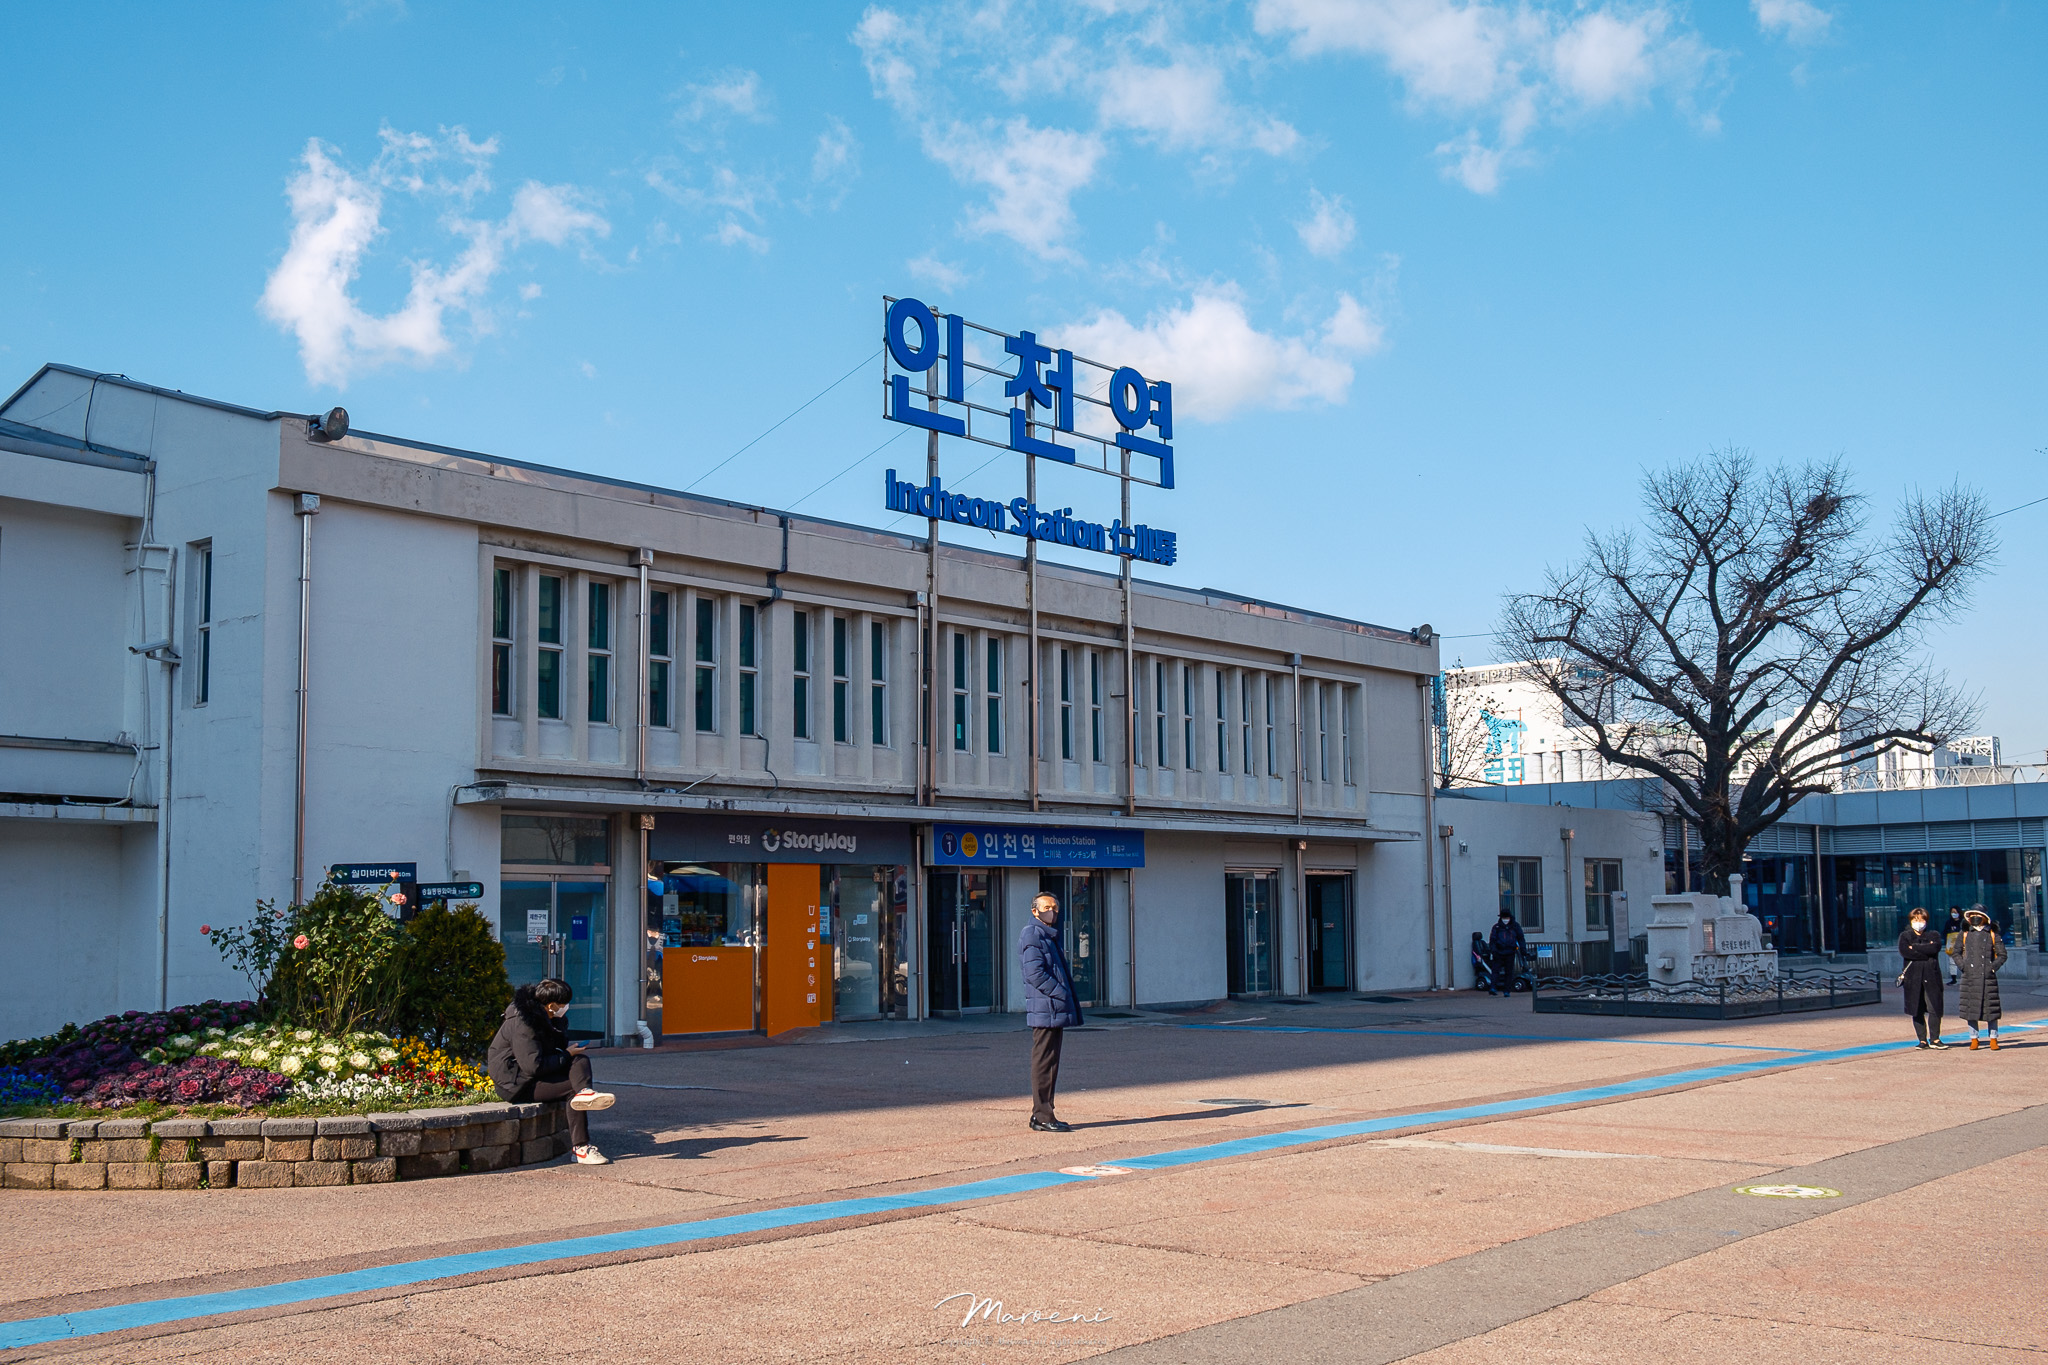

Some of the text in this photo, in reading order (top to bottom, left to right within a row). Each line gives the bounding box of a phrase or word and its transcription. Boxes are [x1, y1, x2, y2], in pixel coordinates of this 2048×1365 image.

[886, 297, 1175, 489] 인천역
[885, 468, 1005, 531] Incheon
[1010, 497, 1105, 551] Station
[1484, 756, 1525, 783] 곰표
[728, 834, 751, 845] 편의점
[783, 830, 856, 853] StoryWay
[946, 841, 952, 853] 1
[984, 833, 1036, 859] 인천역
[1042, 835, 1096, 846] Incheon Station
